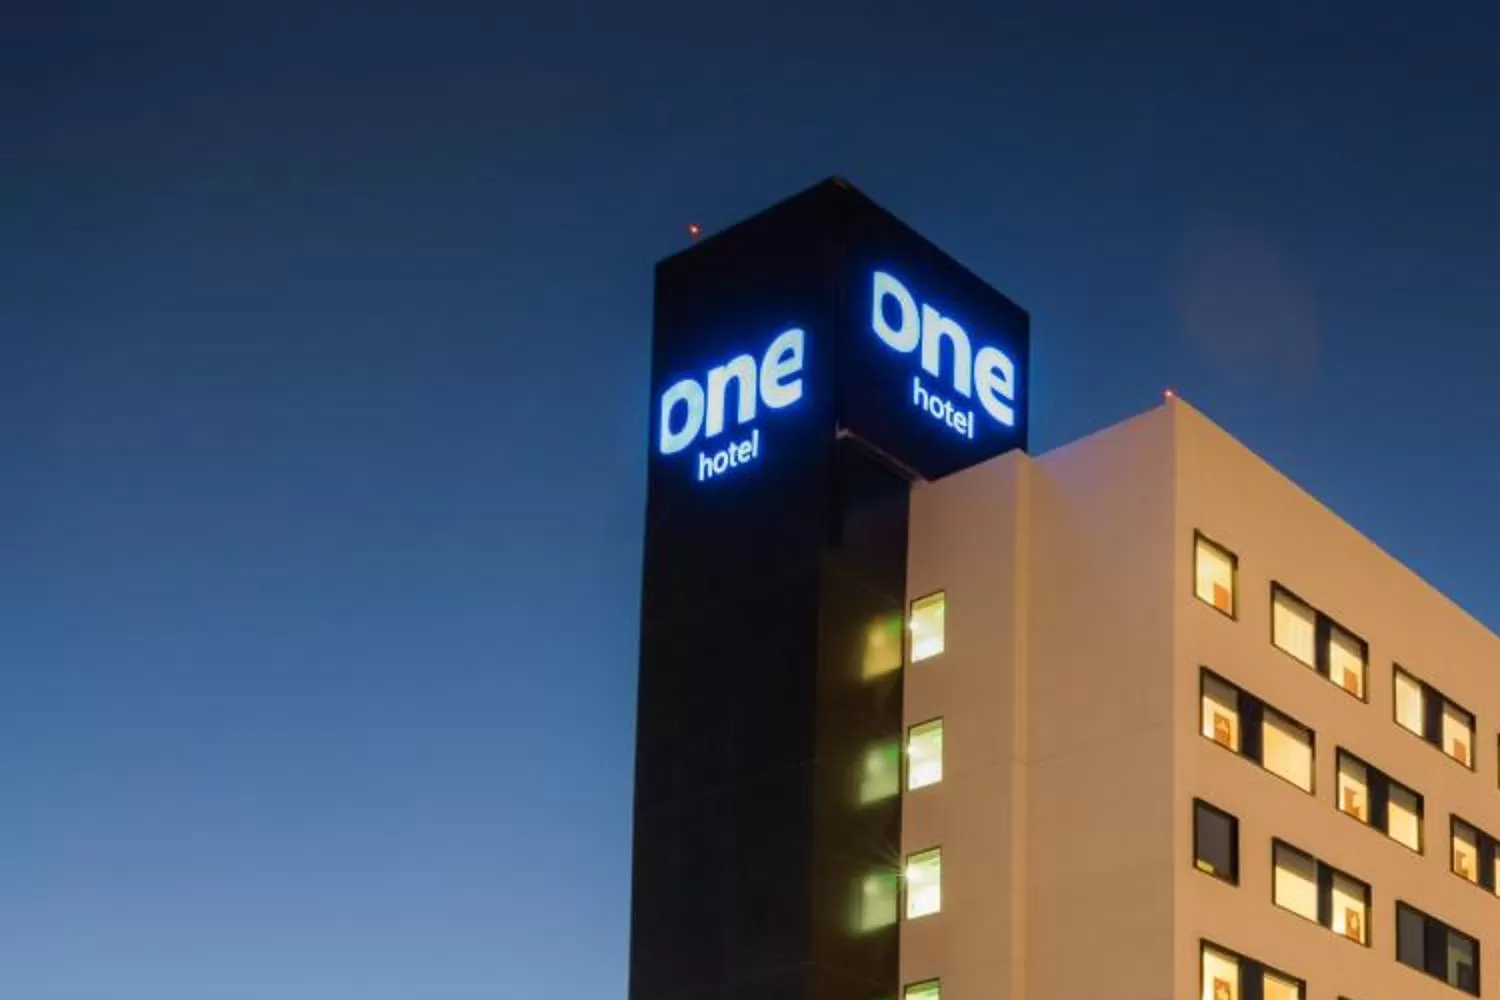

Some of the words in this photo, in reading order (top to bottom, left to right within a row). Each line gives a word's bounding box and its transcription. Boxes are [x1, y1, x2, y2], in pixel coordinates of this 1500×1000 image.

[659, 328, 805, 455] one
[872, 271, 1015, 426] one
[697, 429, 760, 481] hotel
[913, 376, 975, 440] hotel
